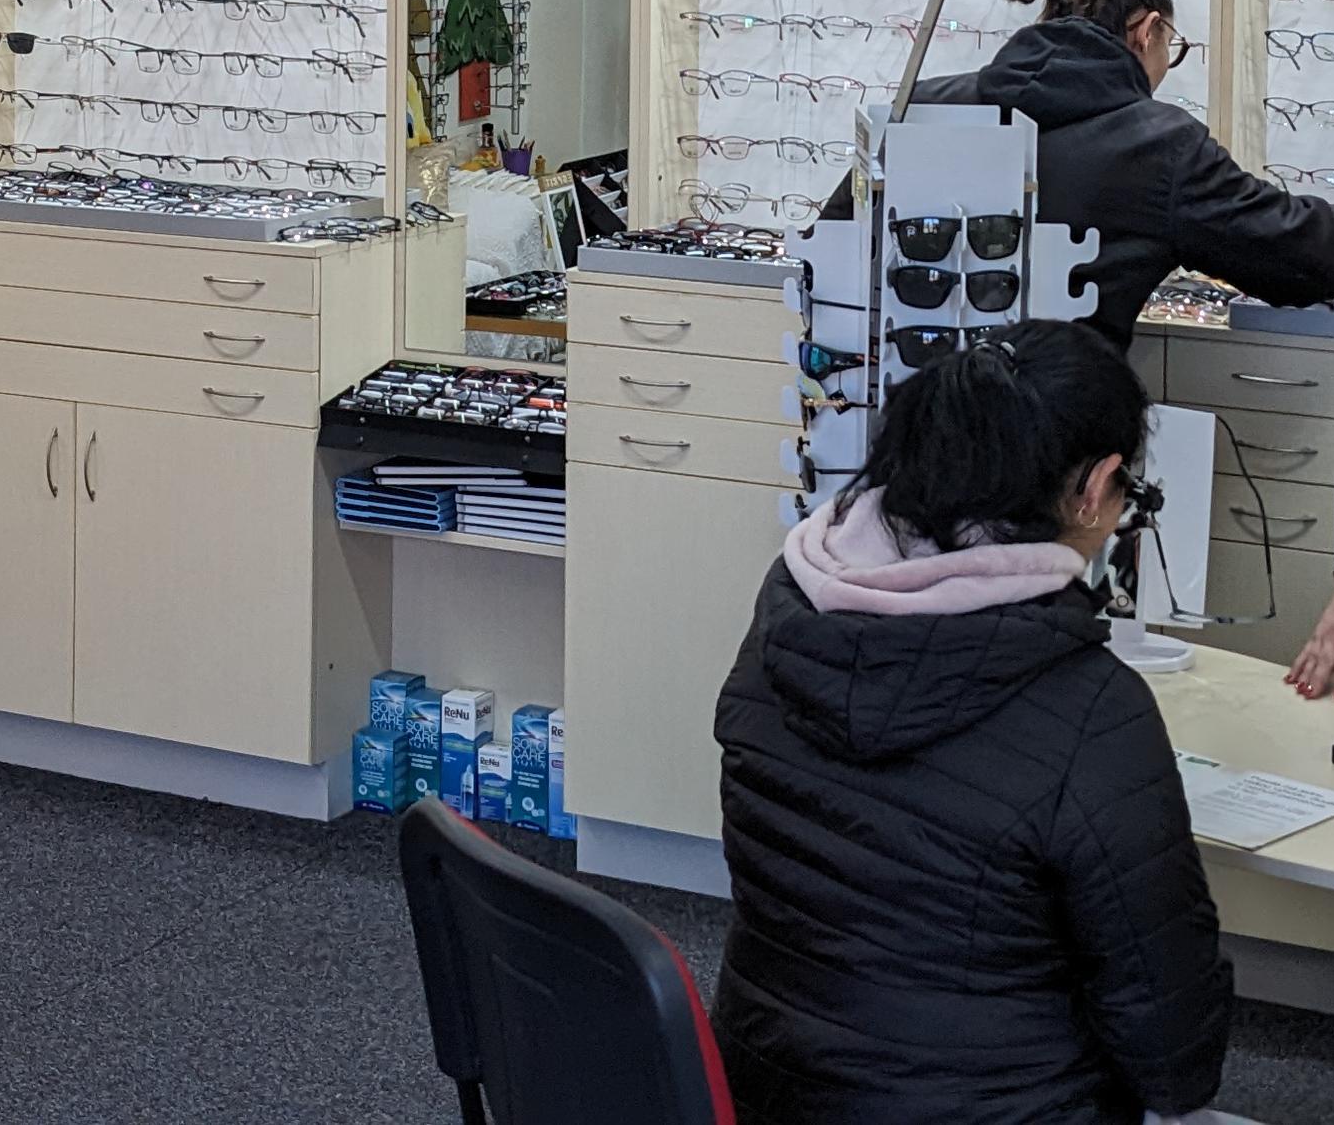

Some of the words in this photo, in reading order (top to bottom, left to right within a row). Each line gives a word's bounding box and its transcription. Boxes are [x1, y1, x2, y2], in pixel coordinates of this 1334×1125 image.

[444, 706, 470, 721] ReNu
[551, 725, 564, 737] Re
[480, 756, 500, 768] ReNu
